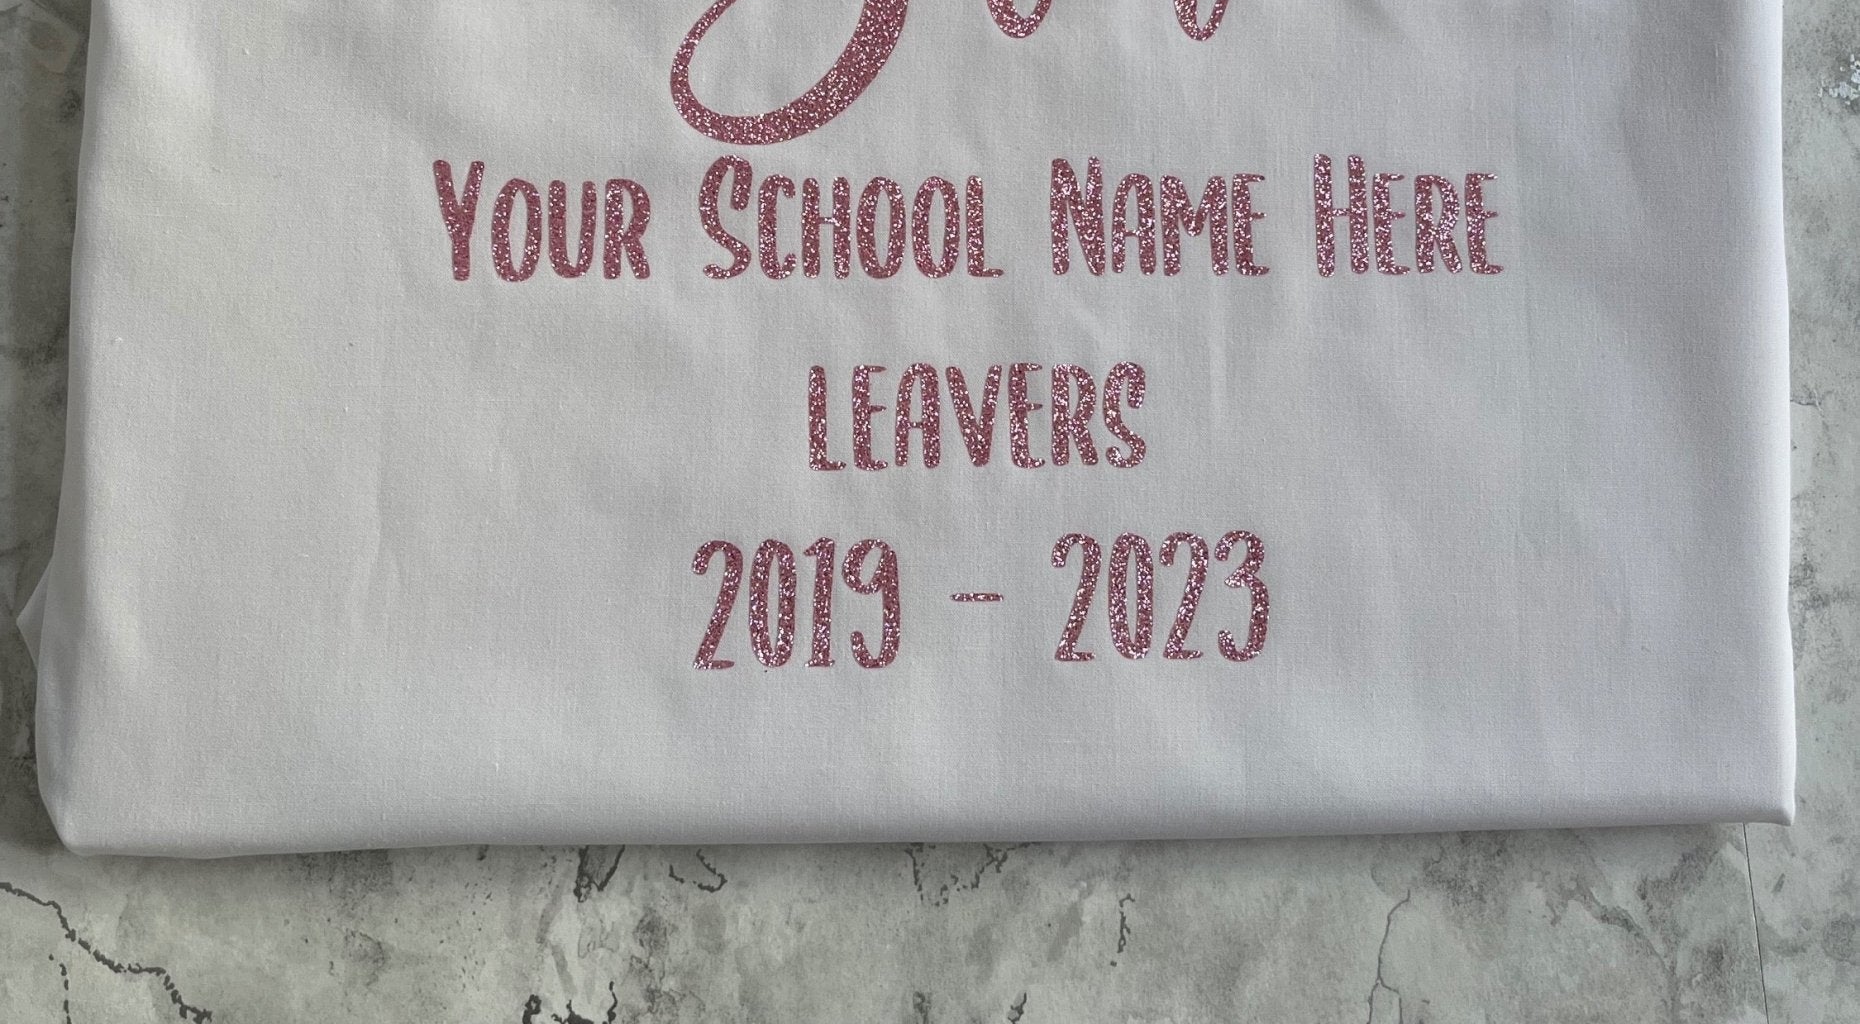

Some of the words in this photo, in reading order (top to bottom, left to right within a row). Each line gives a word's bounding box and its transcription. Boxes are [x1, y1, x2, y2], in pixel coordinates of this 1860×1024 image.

[807, 361, 1146, 472] LEAVERS
[691, 537, 902, 670] 2019
[1051, 530, 1270, 662] 2023
